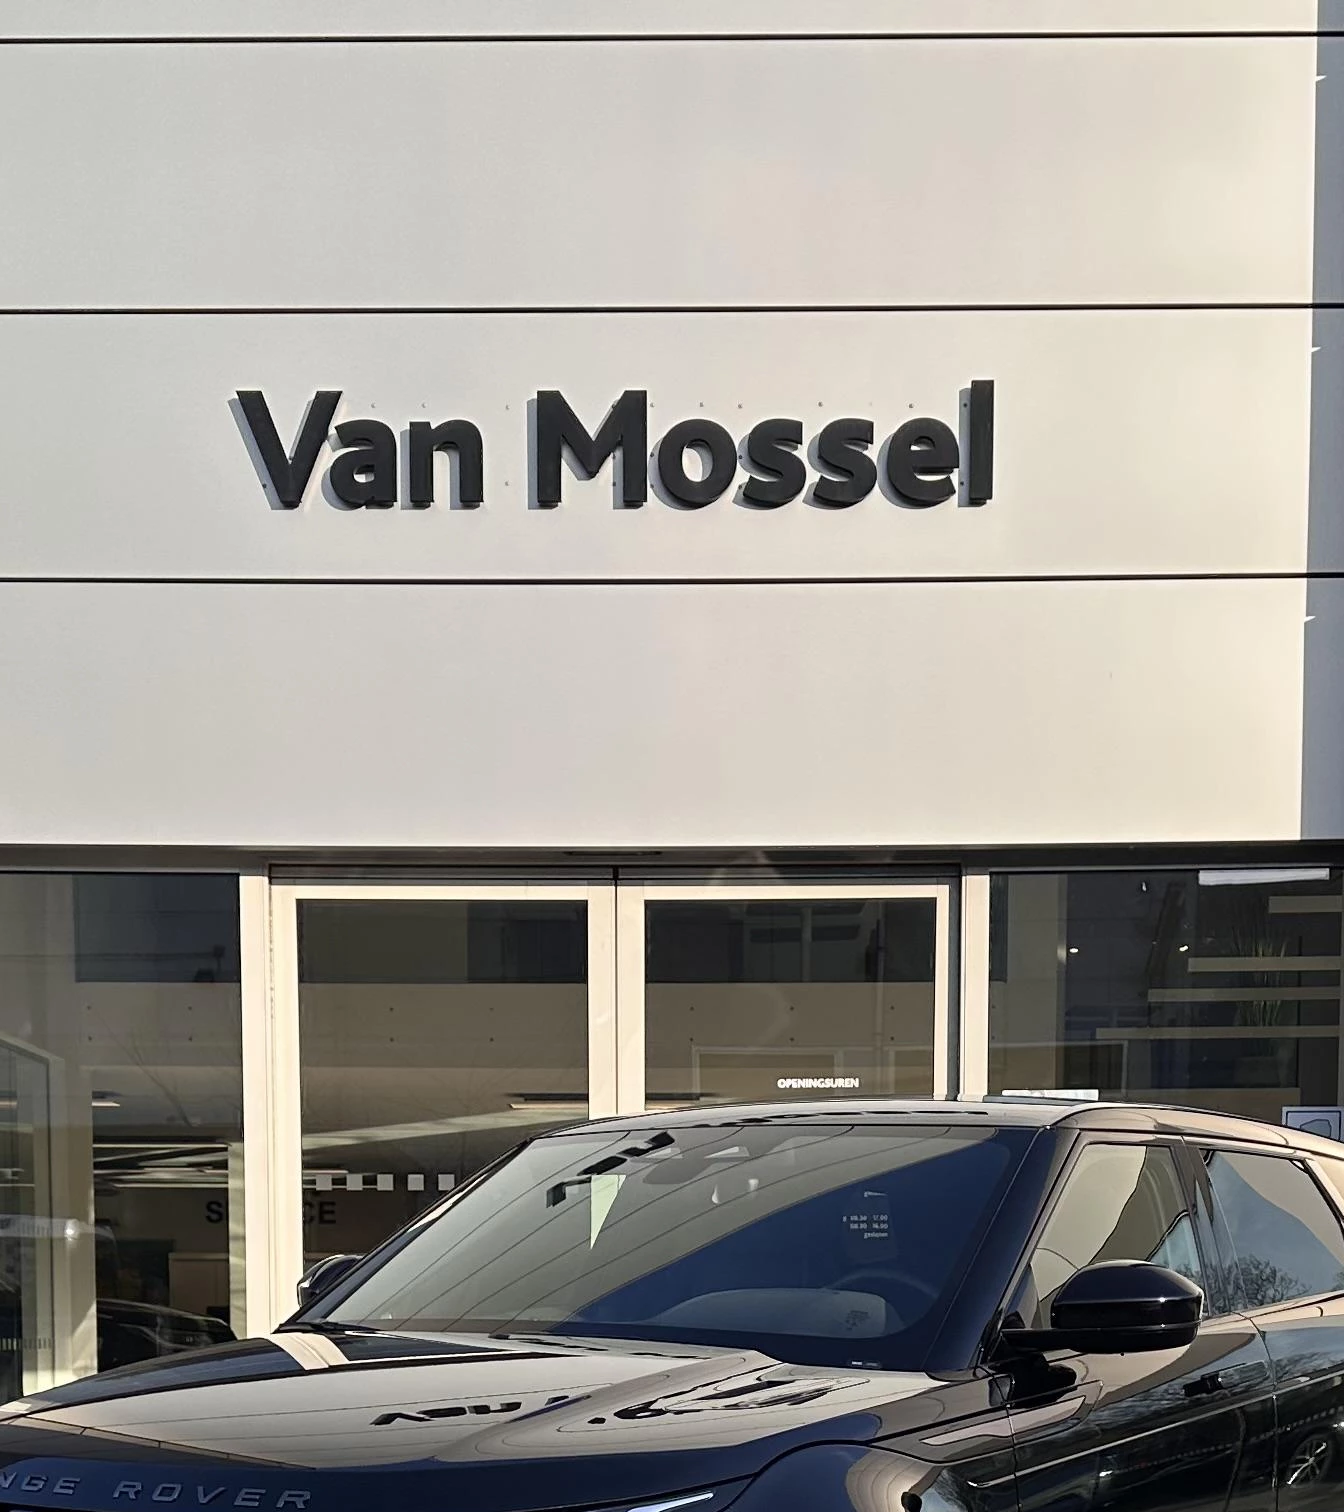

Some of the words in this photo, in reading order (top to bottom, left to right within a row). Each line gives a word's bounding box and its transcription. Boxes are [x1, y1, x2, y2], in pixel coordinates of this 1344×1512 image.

[236, 389, 485, 507] Van
[535, 379, 995, 508] Mossel
[777, 1078, 860, 1089] OPENINGSUREN
[112, 1480, 312, 1510] ROVER
